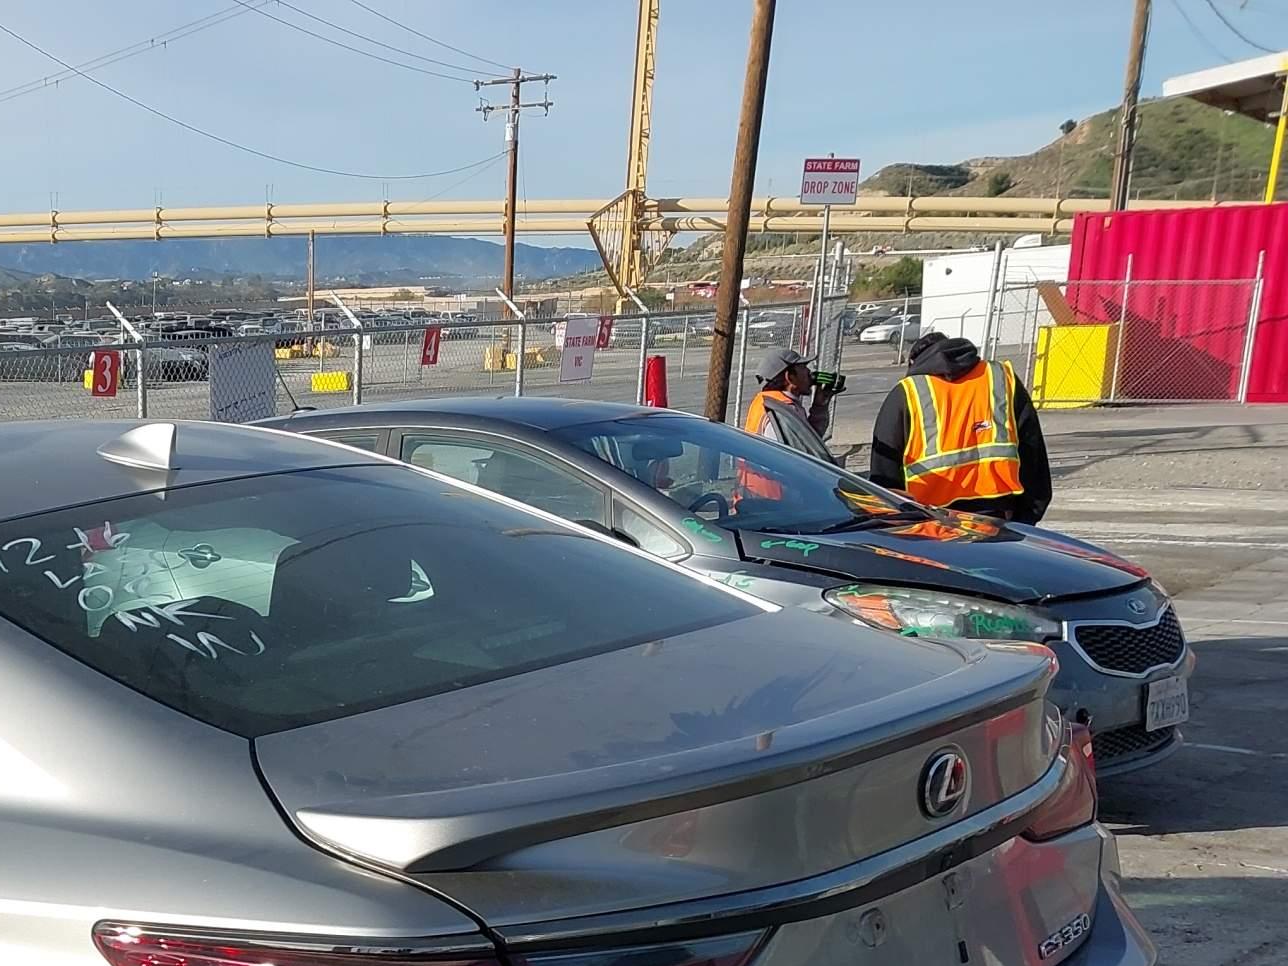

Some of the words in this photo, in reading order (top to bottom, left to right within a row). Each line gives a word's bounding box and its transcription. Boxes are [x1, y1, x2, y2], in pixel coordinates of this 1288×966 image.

[806, 161, 832, 170] STATE
[834, 161, 858, 170] FARM
[803, 181, 829, 194] DROP
[832, 181, 856, 194] ZONE
[425, 331, 437, 362] 4
[97, 355, 112, 393] 3
